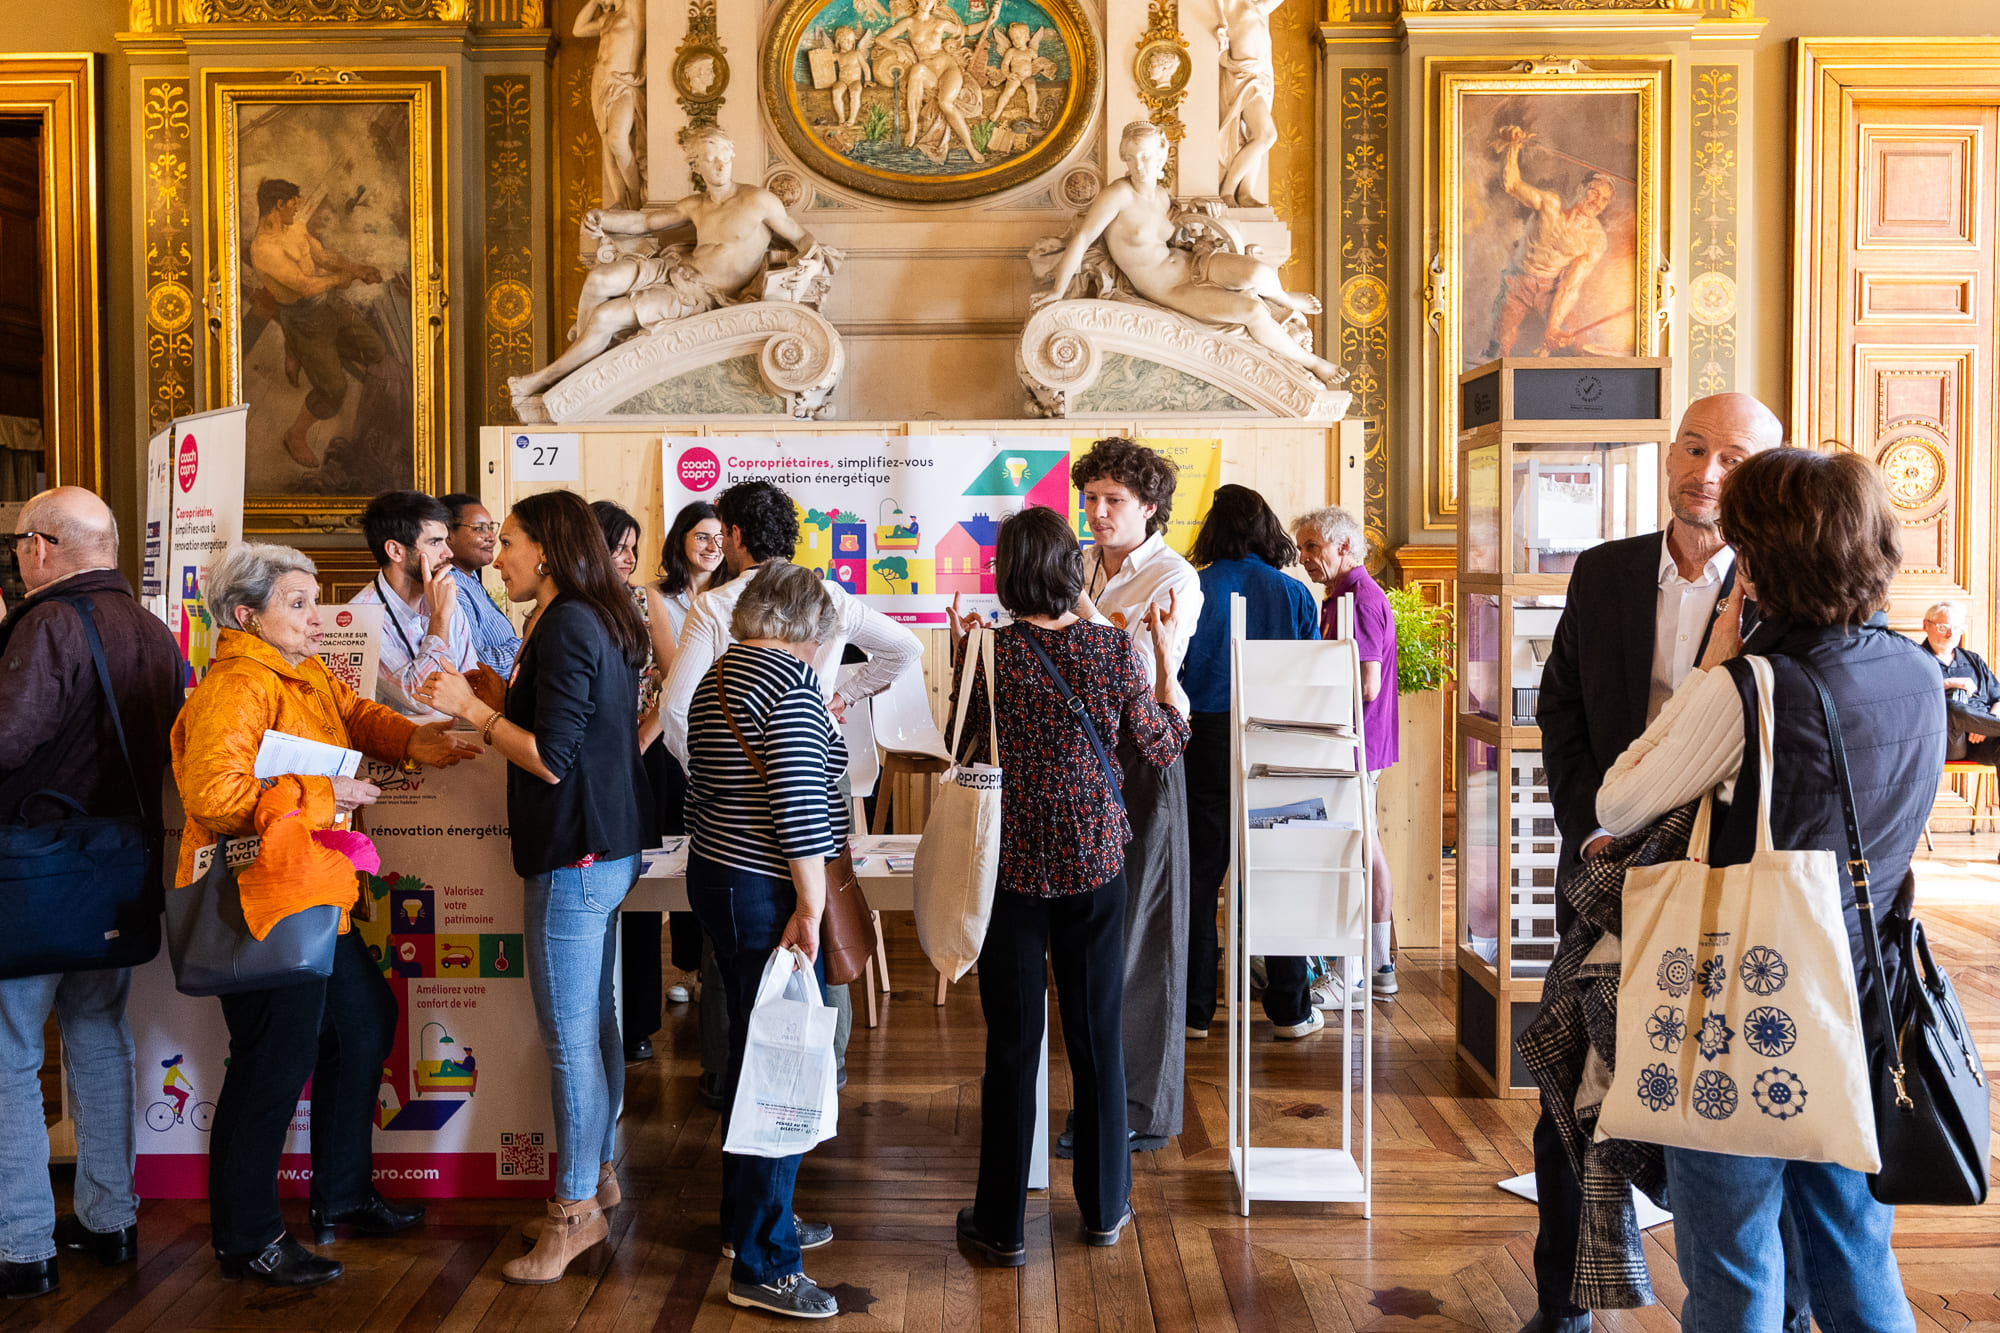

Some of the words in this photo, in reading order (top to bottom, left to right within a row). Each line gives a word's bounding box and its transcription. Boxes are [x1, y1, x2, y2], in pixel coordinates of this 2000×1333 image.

[532, 446, 559, 466] 27
[681, 459, 716, 470] coach
[727, 456, 834, 471] Copropriétaires,
[837, 456, 934, 471] simplifiez-vous
[681, 470, 716, 481] copro
[727, 471, 739, 484] la
[743, 472, 811, 484] rénovation
[815, 472, 891, 487] énergétique
[210, 521, 216, 533] la
[371, 824, 443, 837] rénovation
[443, 886, 485, 896] Valorisez
[444, 902, 468, 910] votre
[444, 914, 495, 926] patrimoine
[416, 984, 462, 994] Améliorez
[463, 985, 487, 994] votre
[416, 998, 449, 1009] confort
[450, 998, 461, 1009] de
[464, 998, 477, 1009] vie
